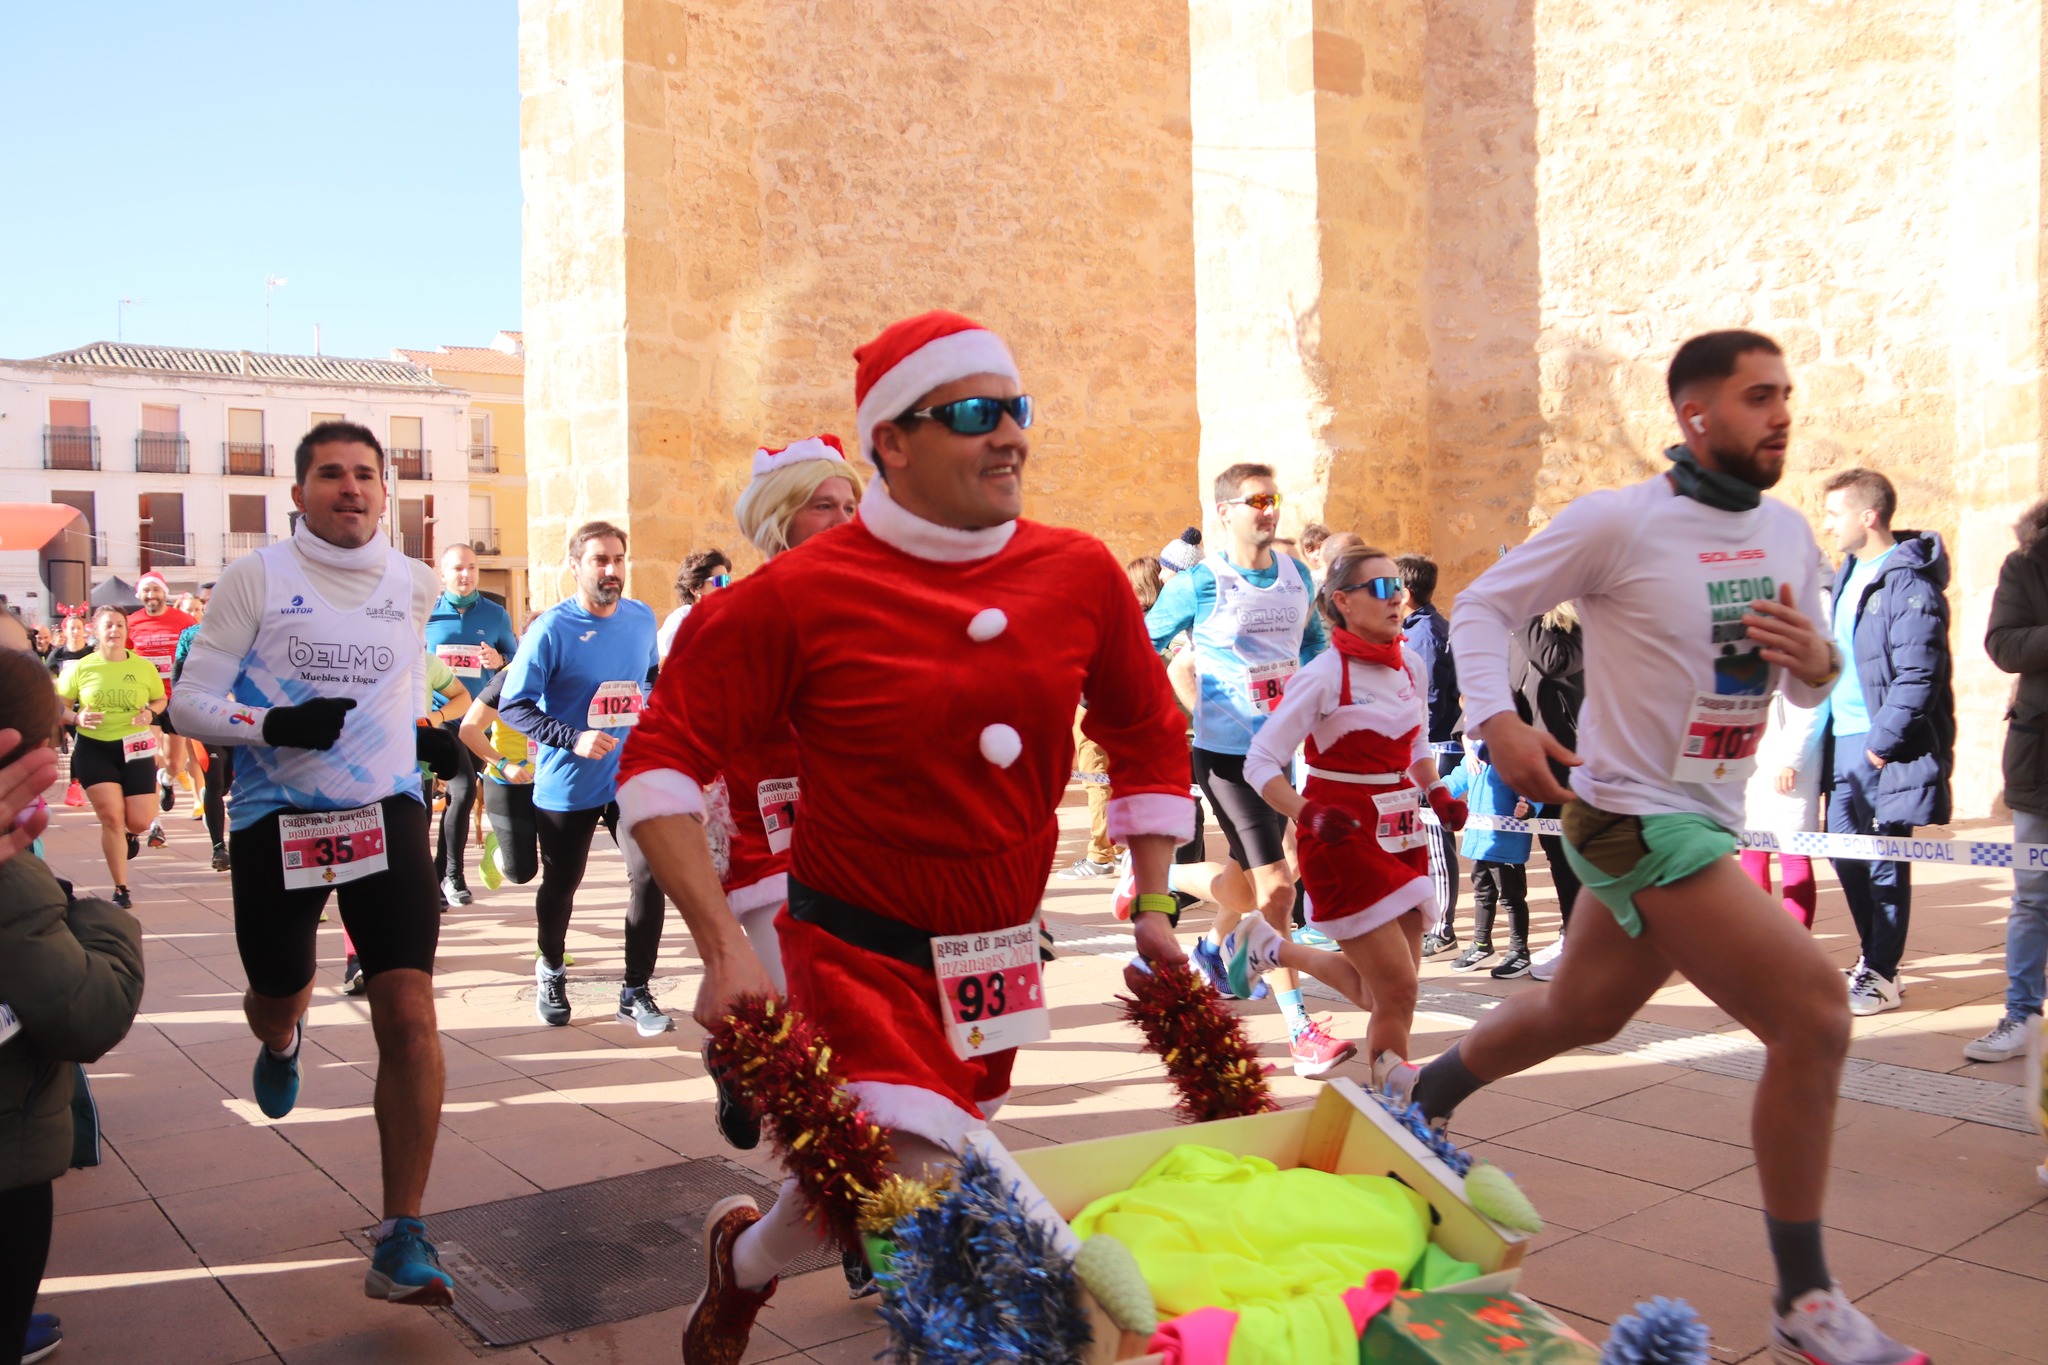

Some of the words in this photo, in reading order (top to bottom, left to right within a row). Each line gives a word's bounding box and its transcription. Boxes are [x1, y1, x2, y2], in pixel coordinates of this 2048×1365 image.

[1706, 576, 1775, 606] MEDIO
[280, 607, 313, 615] VIATOR
[446, 655, 471, 668] 125
[300, 671, 341, 682] Muebles
[341, 674, 350, 683] &
[352, 674, 378, 684] Hogar
[601, 696, 632, 714] 102
[132, 740, 148, 752] 60
[339, 806, 378, 821] navidad
[353, 816, 379, 832] 2024
[315, 835, 354, 867] 35
[1843, 837, 1900, 857] POLICIA
[1904, 840, 1955, 861] LOCAL
[994, 927, 1033, 948] navidad
[1010, 943, 1035, 966] 2024
[957, 971, 1007, 1022] 93
